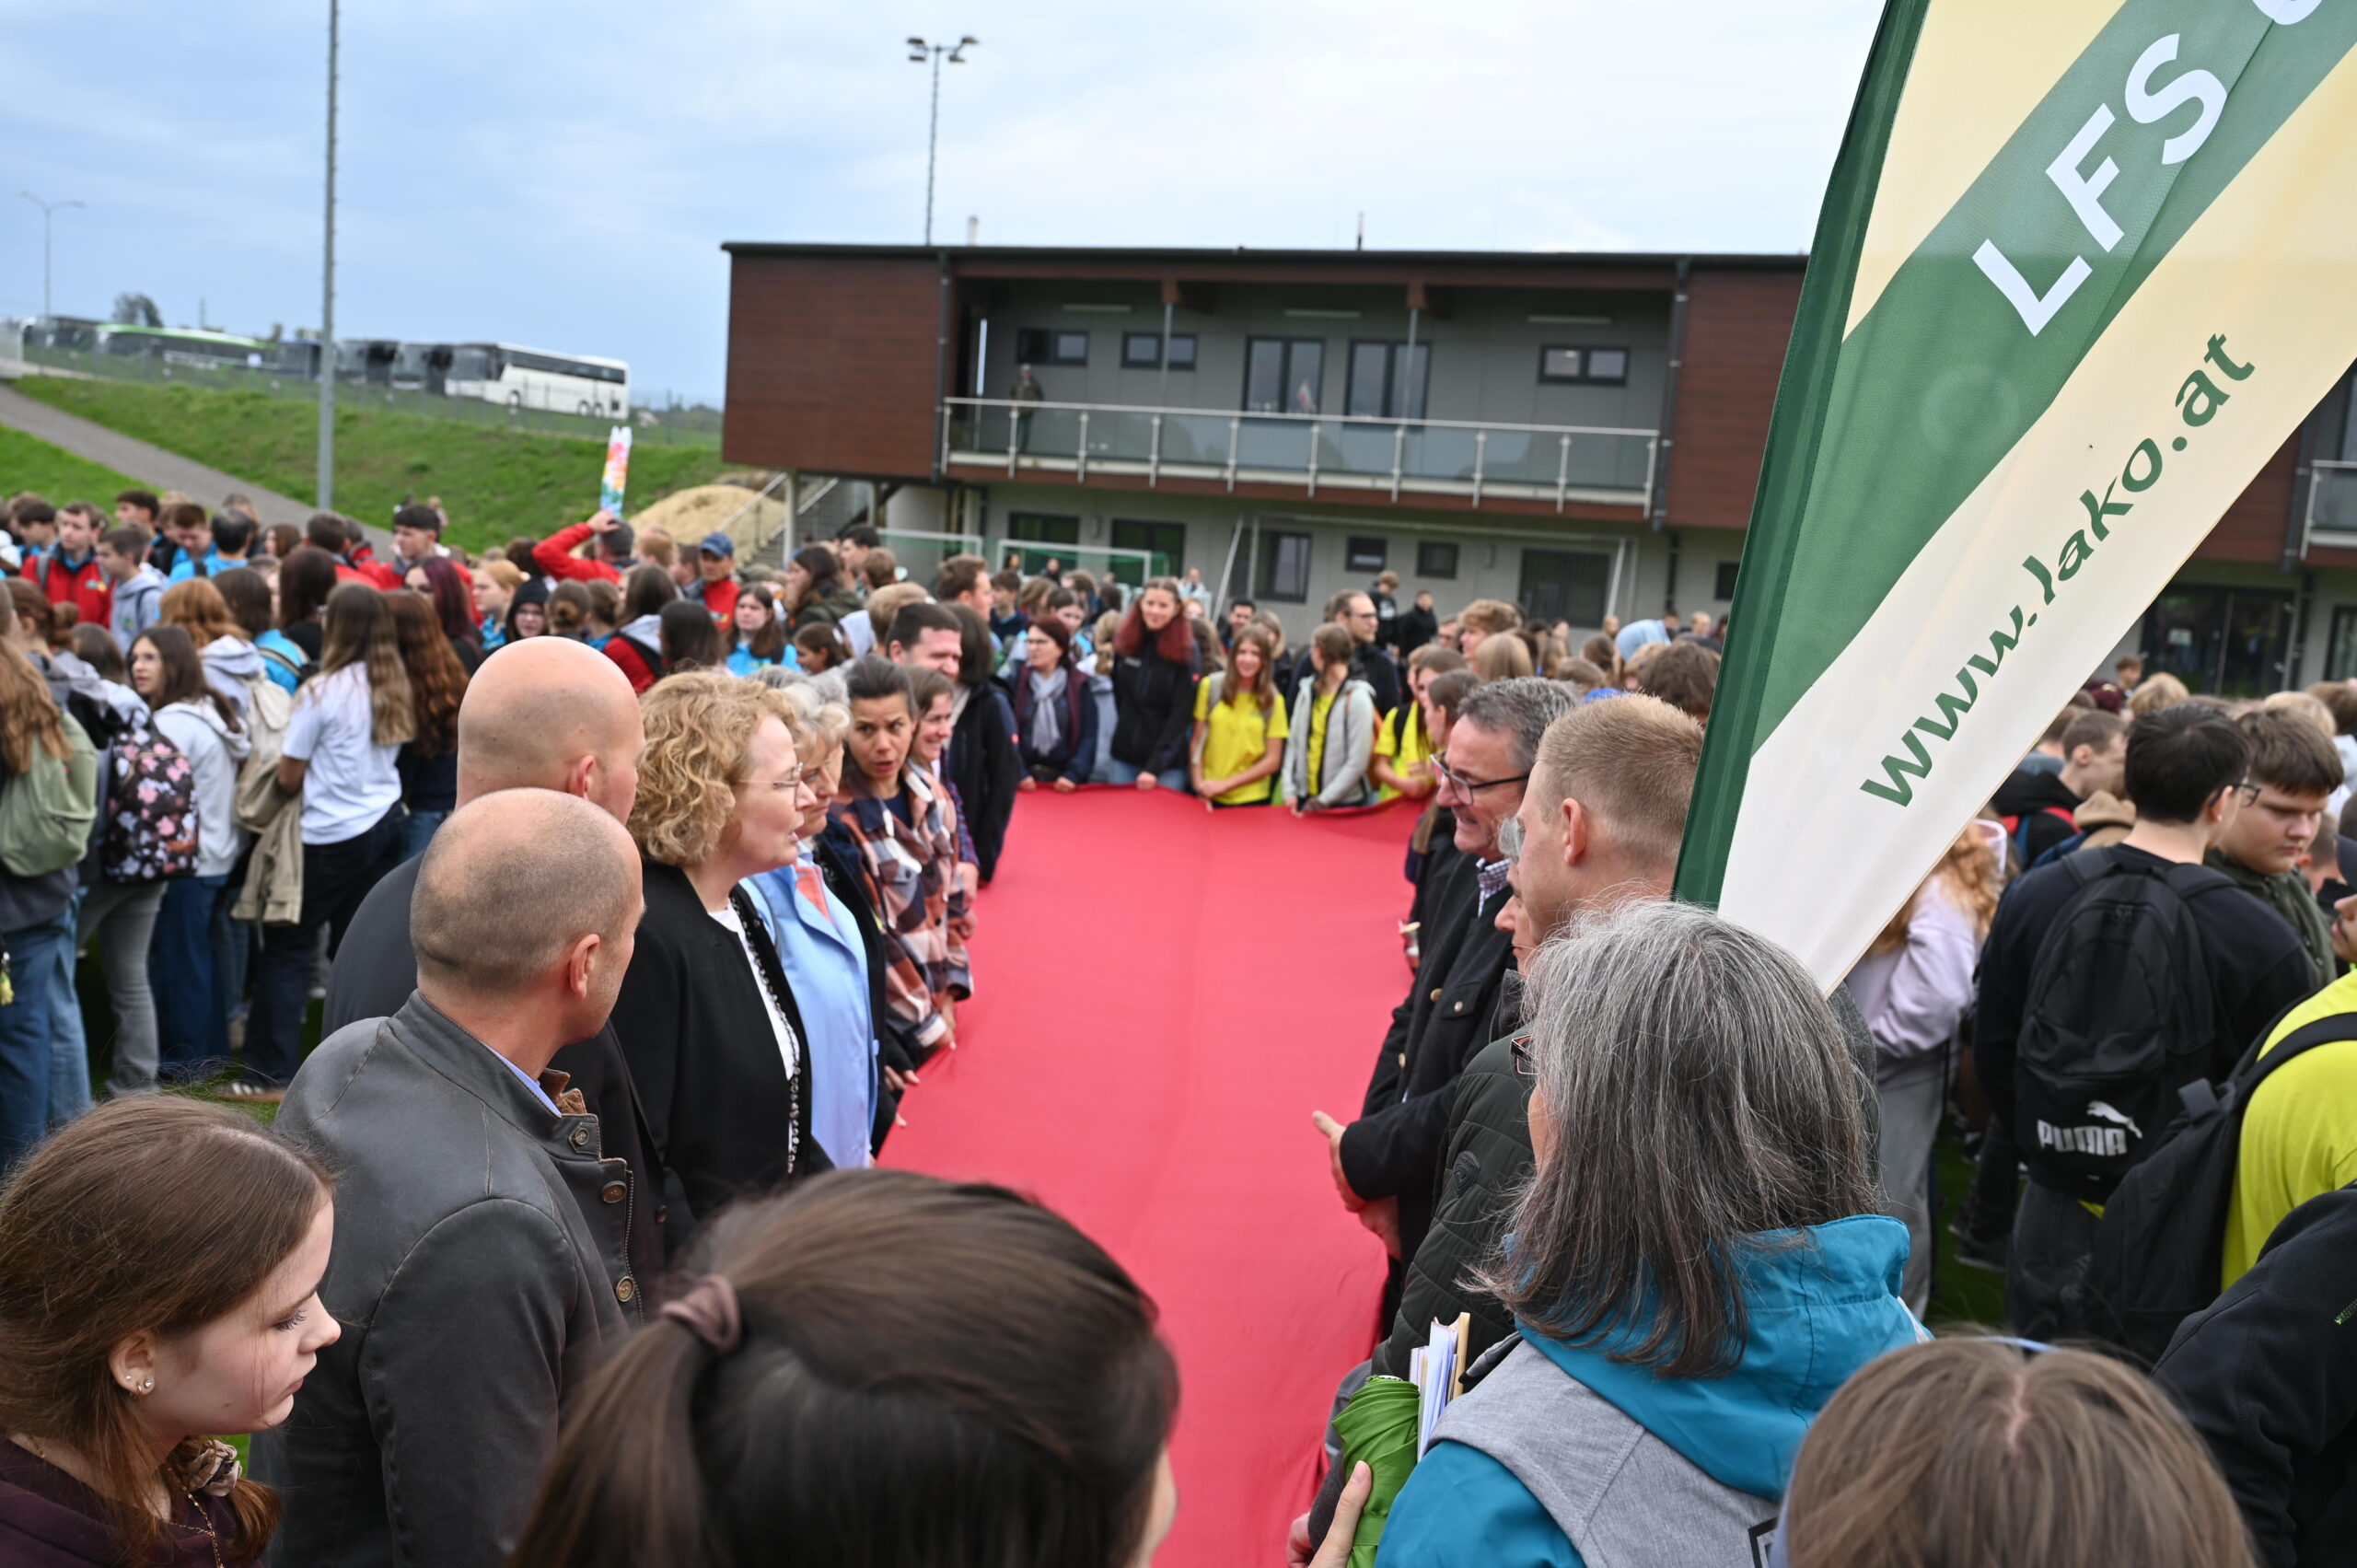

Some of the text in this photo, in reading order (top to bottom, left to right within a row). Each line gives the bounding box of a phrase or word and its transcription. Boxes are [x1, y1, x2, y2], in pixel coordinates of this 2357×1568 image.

[1972, 33, 2228, 337] LFS
[1859, 332, 2256, 808] www.lako.at
[2037, 1119, 2127, 1156] PUMA
